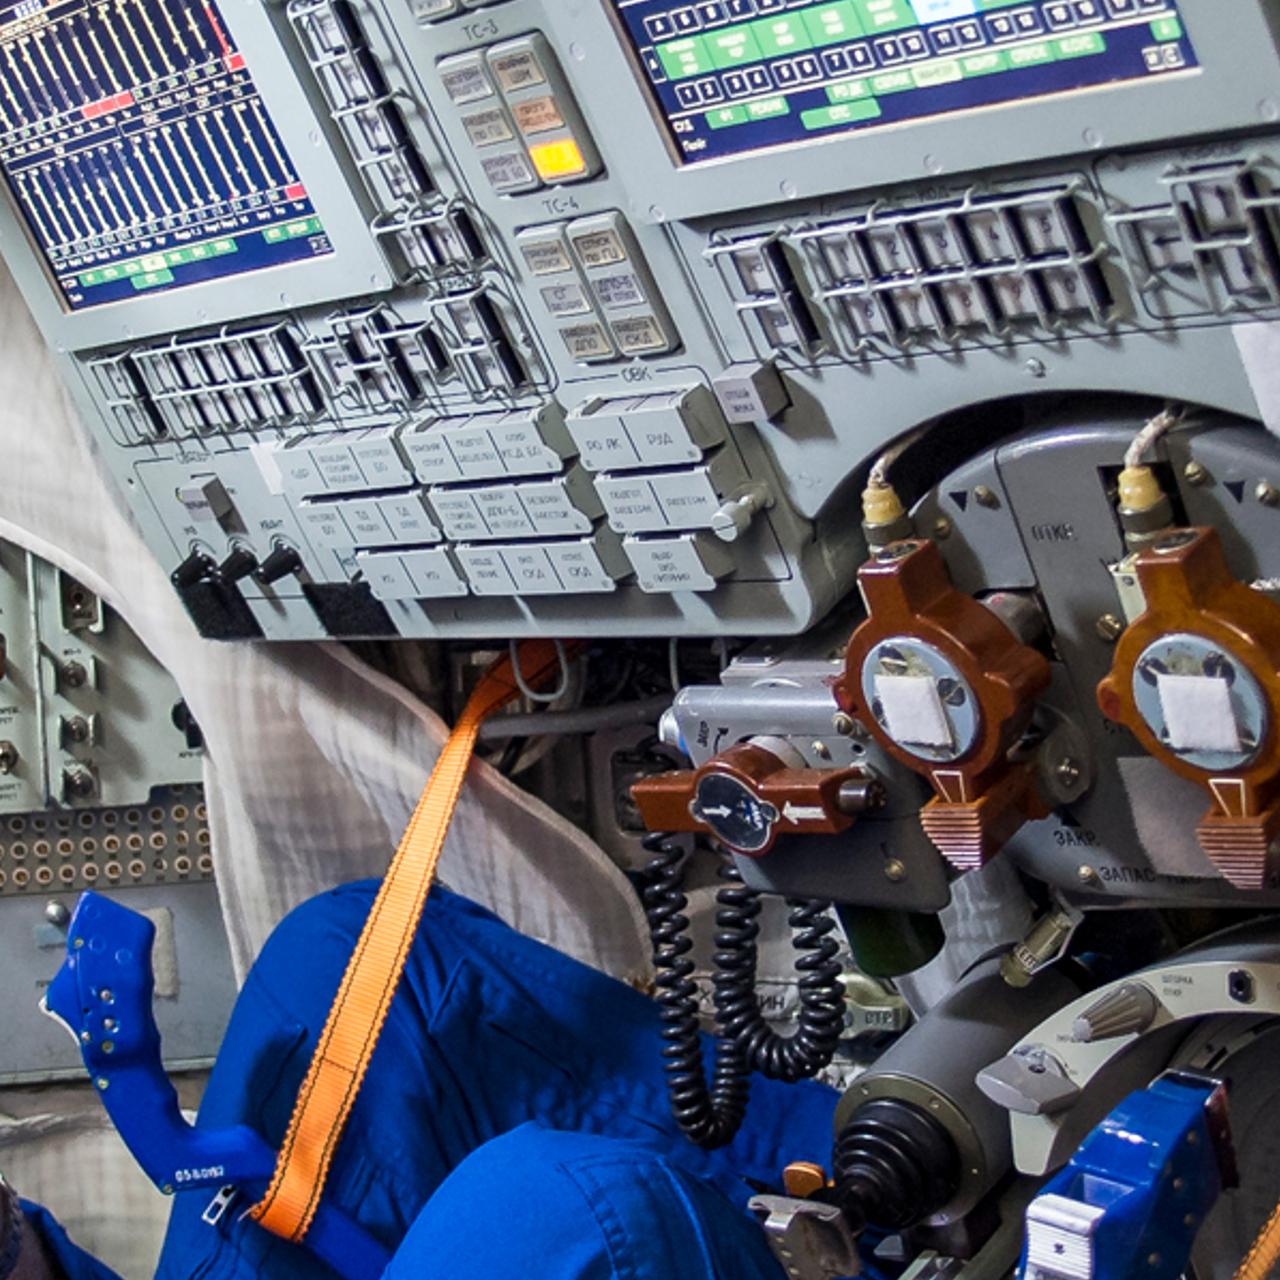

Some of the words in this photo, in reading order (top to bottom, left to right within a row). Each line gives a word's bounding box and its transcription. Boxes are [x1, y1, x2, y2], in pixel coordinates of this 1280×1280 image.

[462, 19, 498, 41] ТС-3
[542, 197, 579, 214] ТС-4
[622, 366, 652, 382] ОВК
[646, 433, 673, 447] РУД
[1053, 828, 1101, 848] ЗАКР.
[1100, 865, 1157, 884] ЗАПАС
